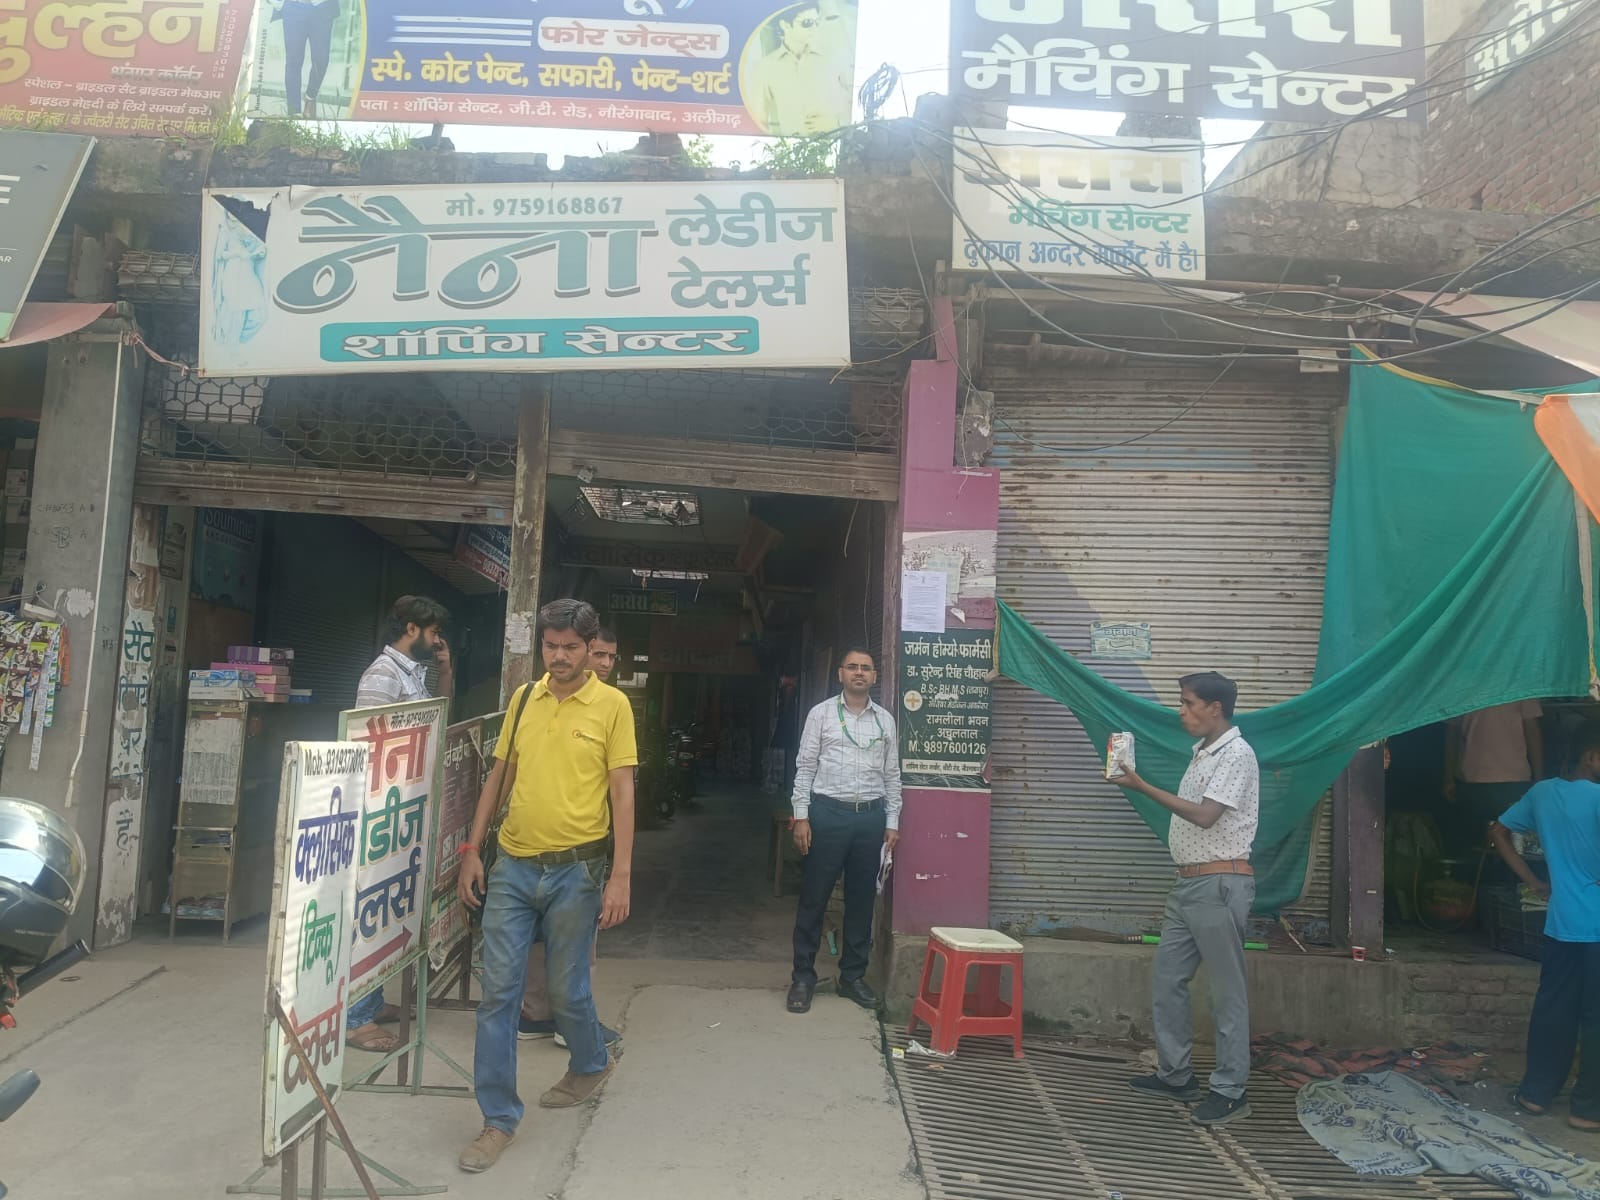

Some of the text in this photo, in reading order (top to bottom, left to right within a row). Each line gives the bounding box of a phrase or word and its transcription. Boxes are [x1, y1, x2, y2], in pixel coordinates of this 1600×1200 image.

[541, 20, 608, 47] फोर
[371, 50, 411, 82] स्पे.
[420, 51, 473, 84] कोट
[537, 55, 622, 92] सफारी,
[961, 33, 1416, 118] मैचिंग सेन्टर
[24, 77, 63, 90] स्पेशल
[75, 81, 116, 93] ब्राइडल
[138, 86, 178, 98] ब्राइडल
[360, 100, 387, 112] पता
[494, 196, 624, 217] 9759168867
[665, 192, 838, 248] लेडीज
[1107, 204, 1191, 234] सेन्टर
[272, 193, 659, 314] नैना
[1028, 241, 1086, 266] अन्दर
[667, 253, 811, 309] टेलर्स
[341, 324, 754, 358] शॉपिंग सेन्टर
[904, 637, 930, 656] जर्मन
[920, 663, 944, 681] सुरेन्द्र
[945, 663, 963, 679] सिंह
[926, 711, 989, 727] रामलीला भवन
[908, 739, 987, 755] M. 9897600126
[304, 748, 323, 776] Mob.
[294, 785, 358, 885] क्लासिक
